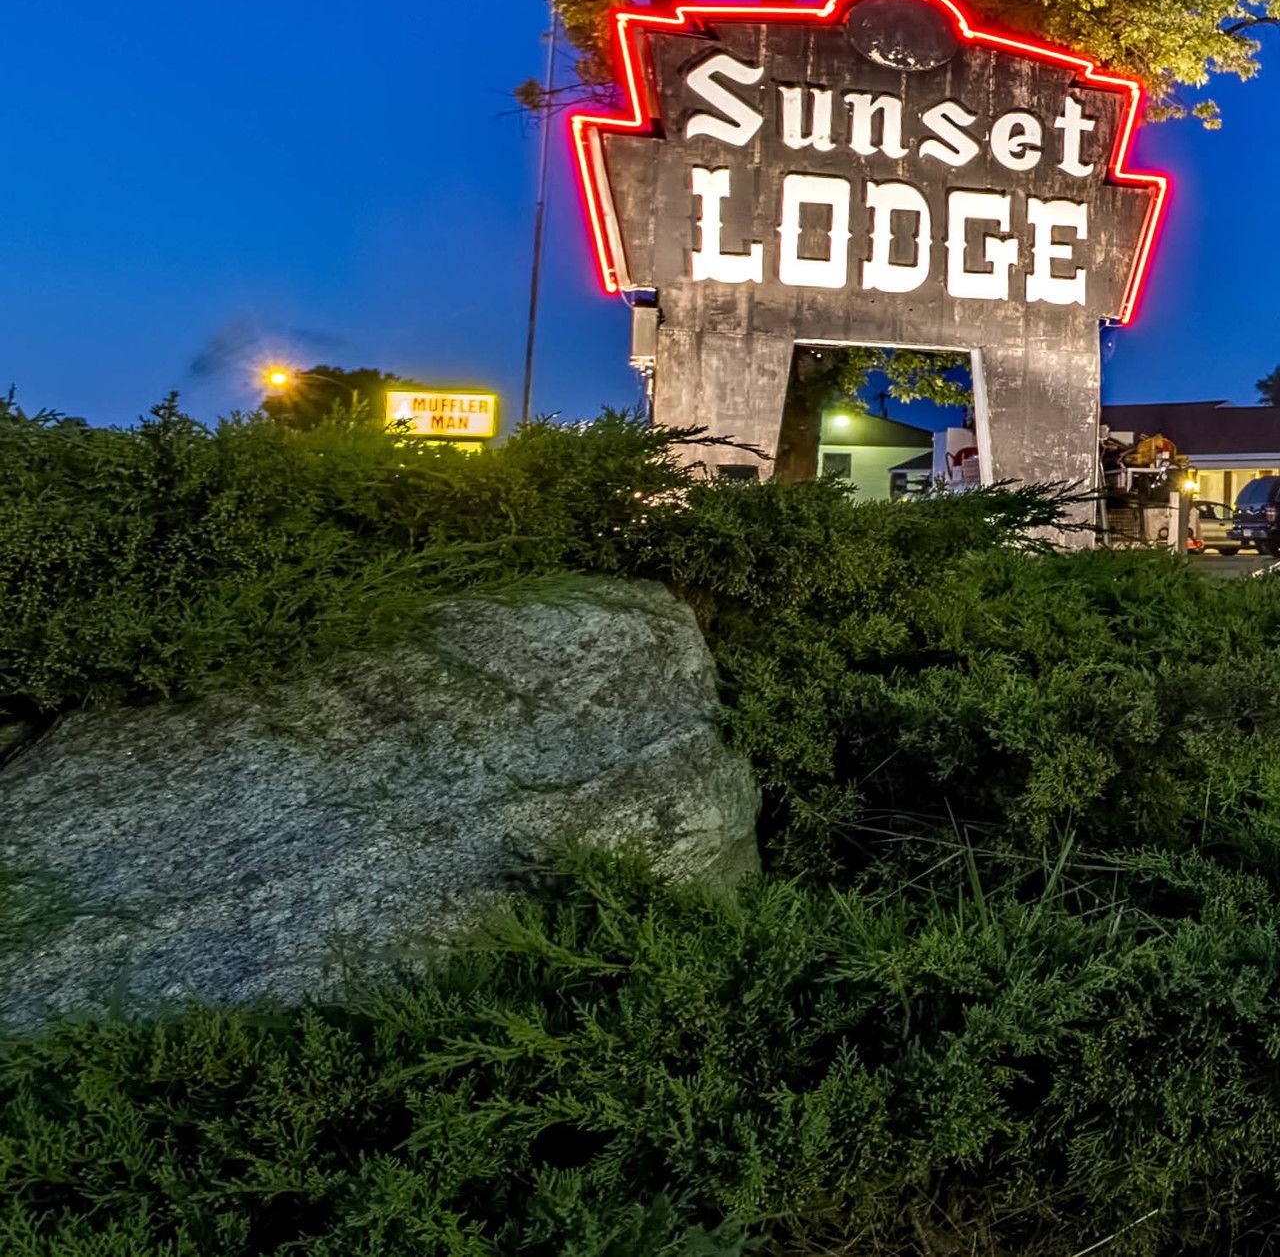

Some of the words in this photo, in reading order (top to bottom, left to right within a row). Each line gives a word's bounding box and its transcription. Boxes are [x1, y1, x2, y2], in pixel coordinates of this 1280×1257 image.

[686, 54, 1096, 177] Sunset
[692, 165, 1088, 305] LODGE
[413, 398, 488, 413] MUFFLER
[431, 416, 469, 429] MAN
